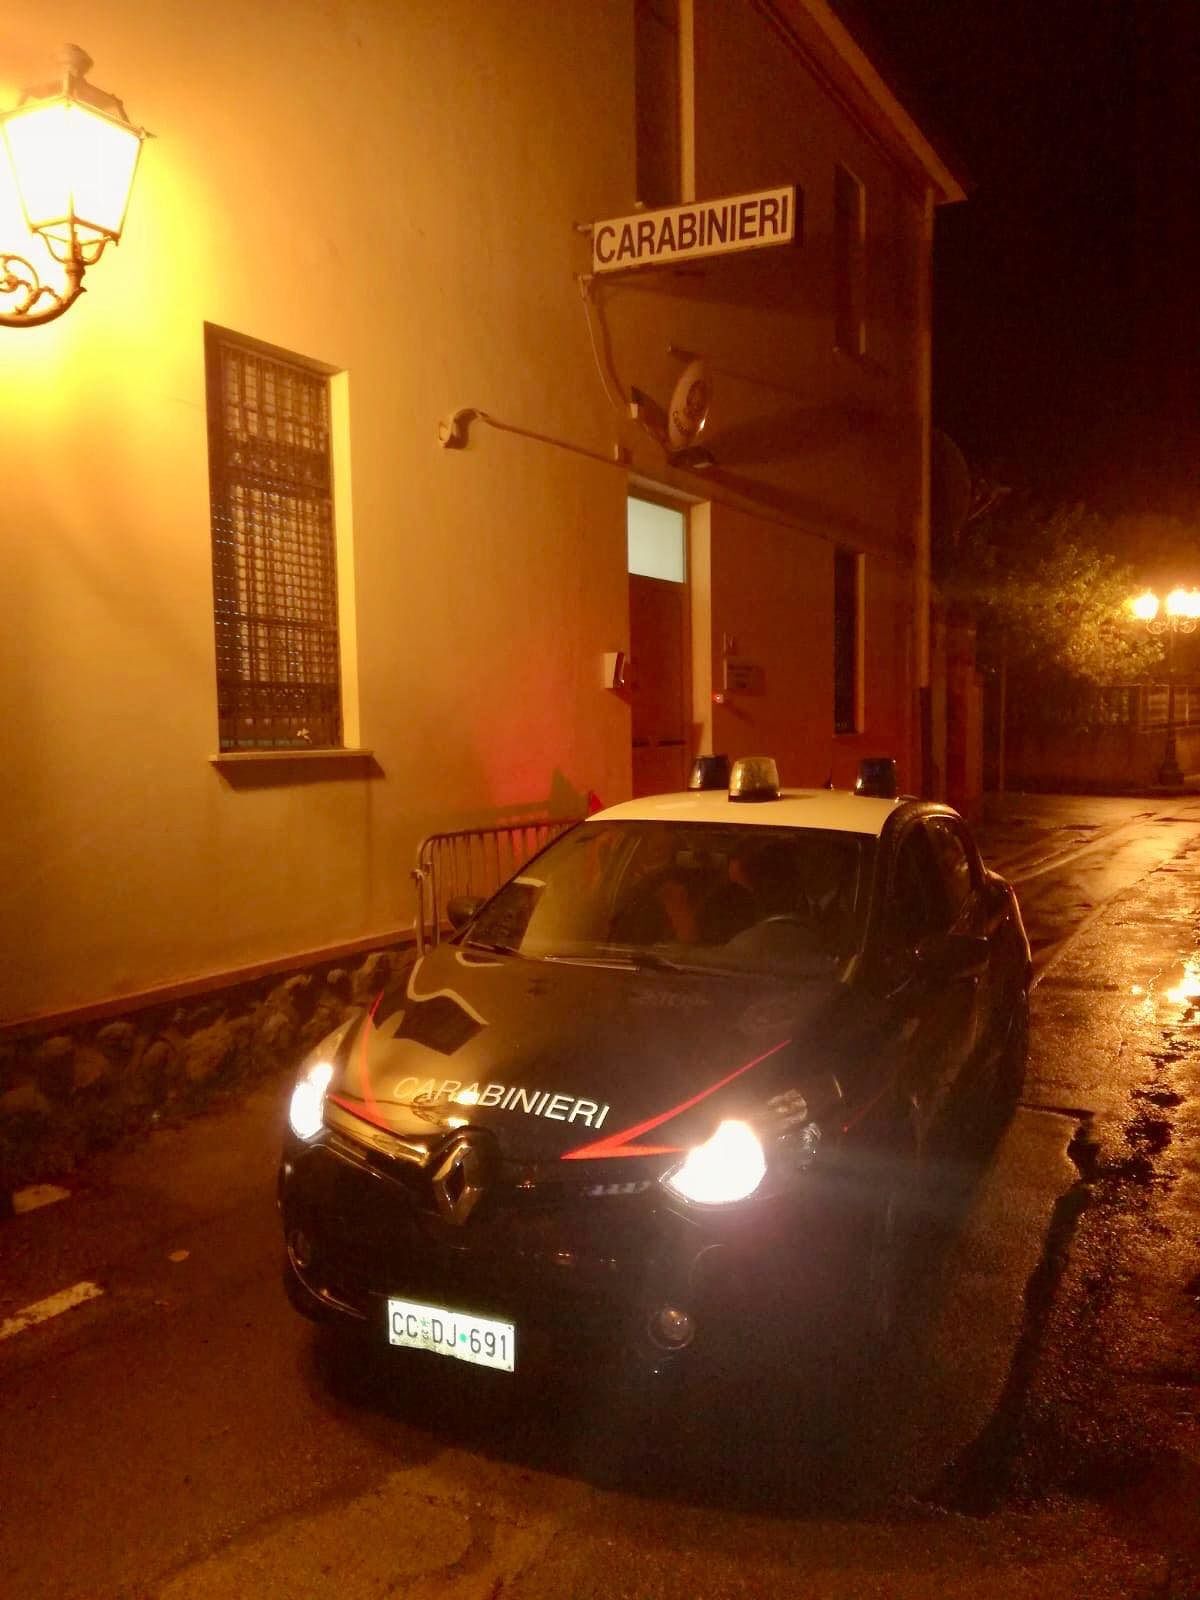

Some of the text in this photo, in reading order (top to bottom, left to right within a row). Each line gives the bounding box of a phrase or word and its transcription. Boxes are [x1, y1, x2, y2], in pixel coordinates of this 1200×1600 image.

[595, 195, 789, 263] CARABINIERI
[393, 1076, 610, 1129] CARABINIERI
[392, 1311, 418, 1339] CC
[431, 1318, 457, 1348] DJ
[470, 1328, 506, 1361] 691
